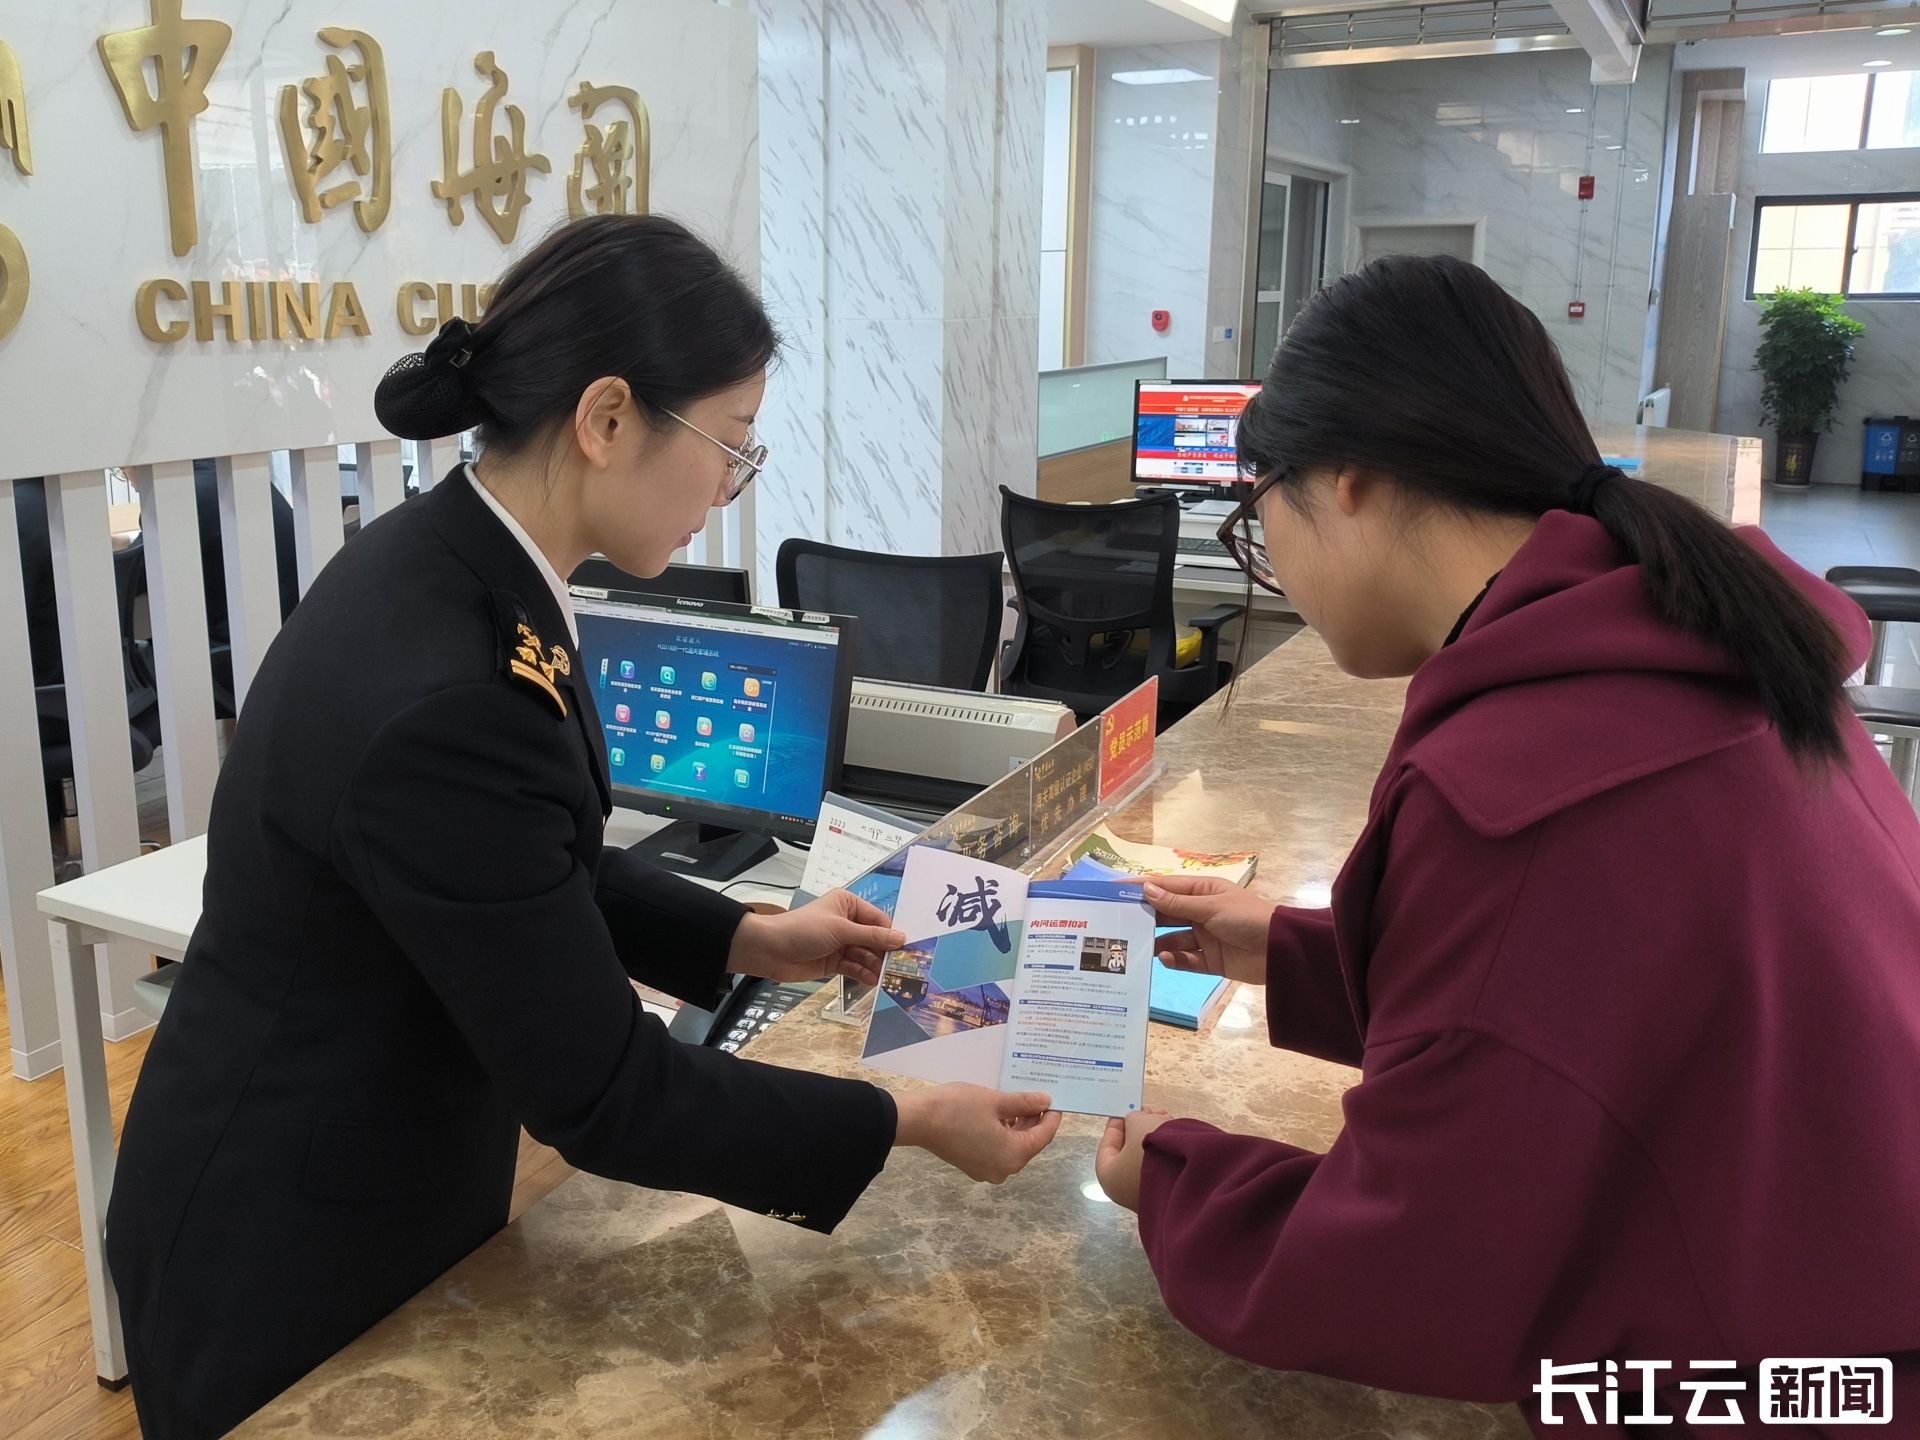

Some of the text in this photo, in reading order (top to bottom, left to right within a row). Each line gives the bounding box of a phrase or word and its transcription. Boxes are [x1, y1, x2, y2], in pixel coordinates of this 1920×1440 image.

[136, 279, 500, 343] CHINA CU
[676, 599, 704, 608] lenovo
[1030, 919, 1089, 929] 内河运费扣减
